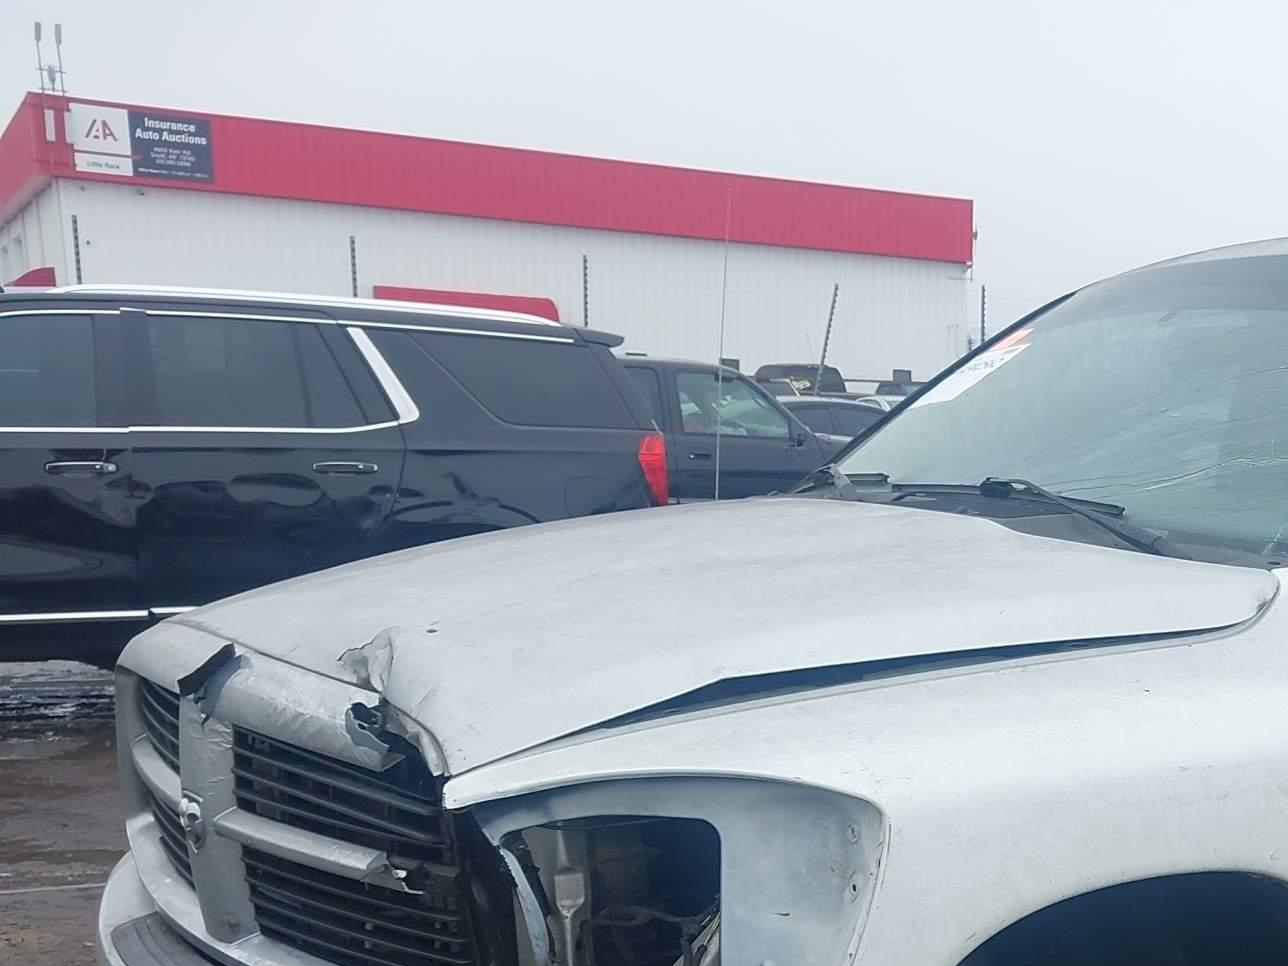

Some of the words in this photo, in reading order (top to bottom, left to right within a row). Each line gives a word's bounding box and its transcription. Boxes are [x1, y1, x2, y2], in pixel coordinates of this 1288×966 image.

[144, 117, 196, 133] Insurance
[135, 128, 160, 140] Auto
[161, 131, 207, 145] Auctions
